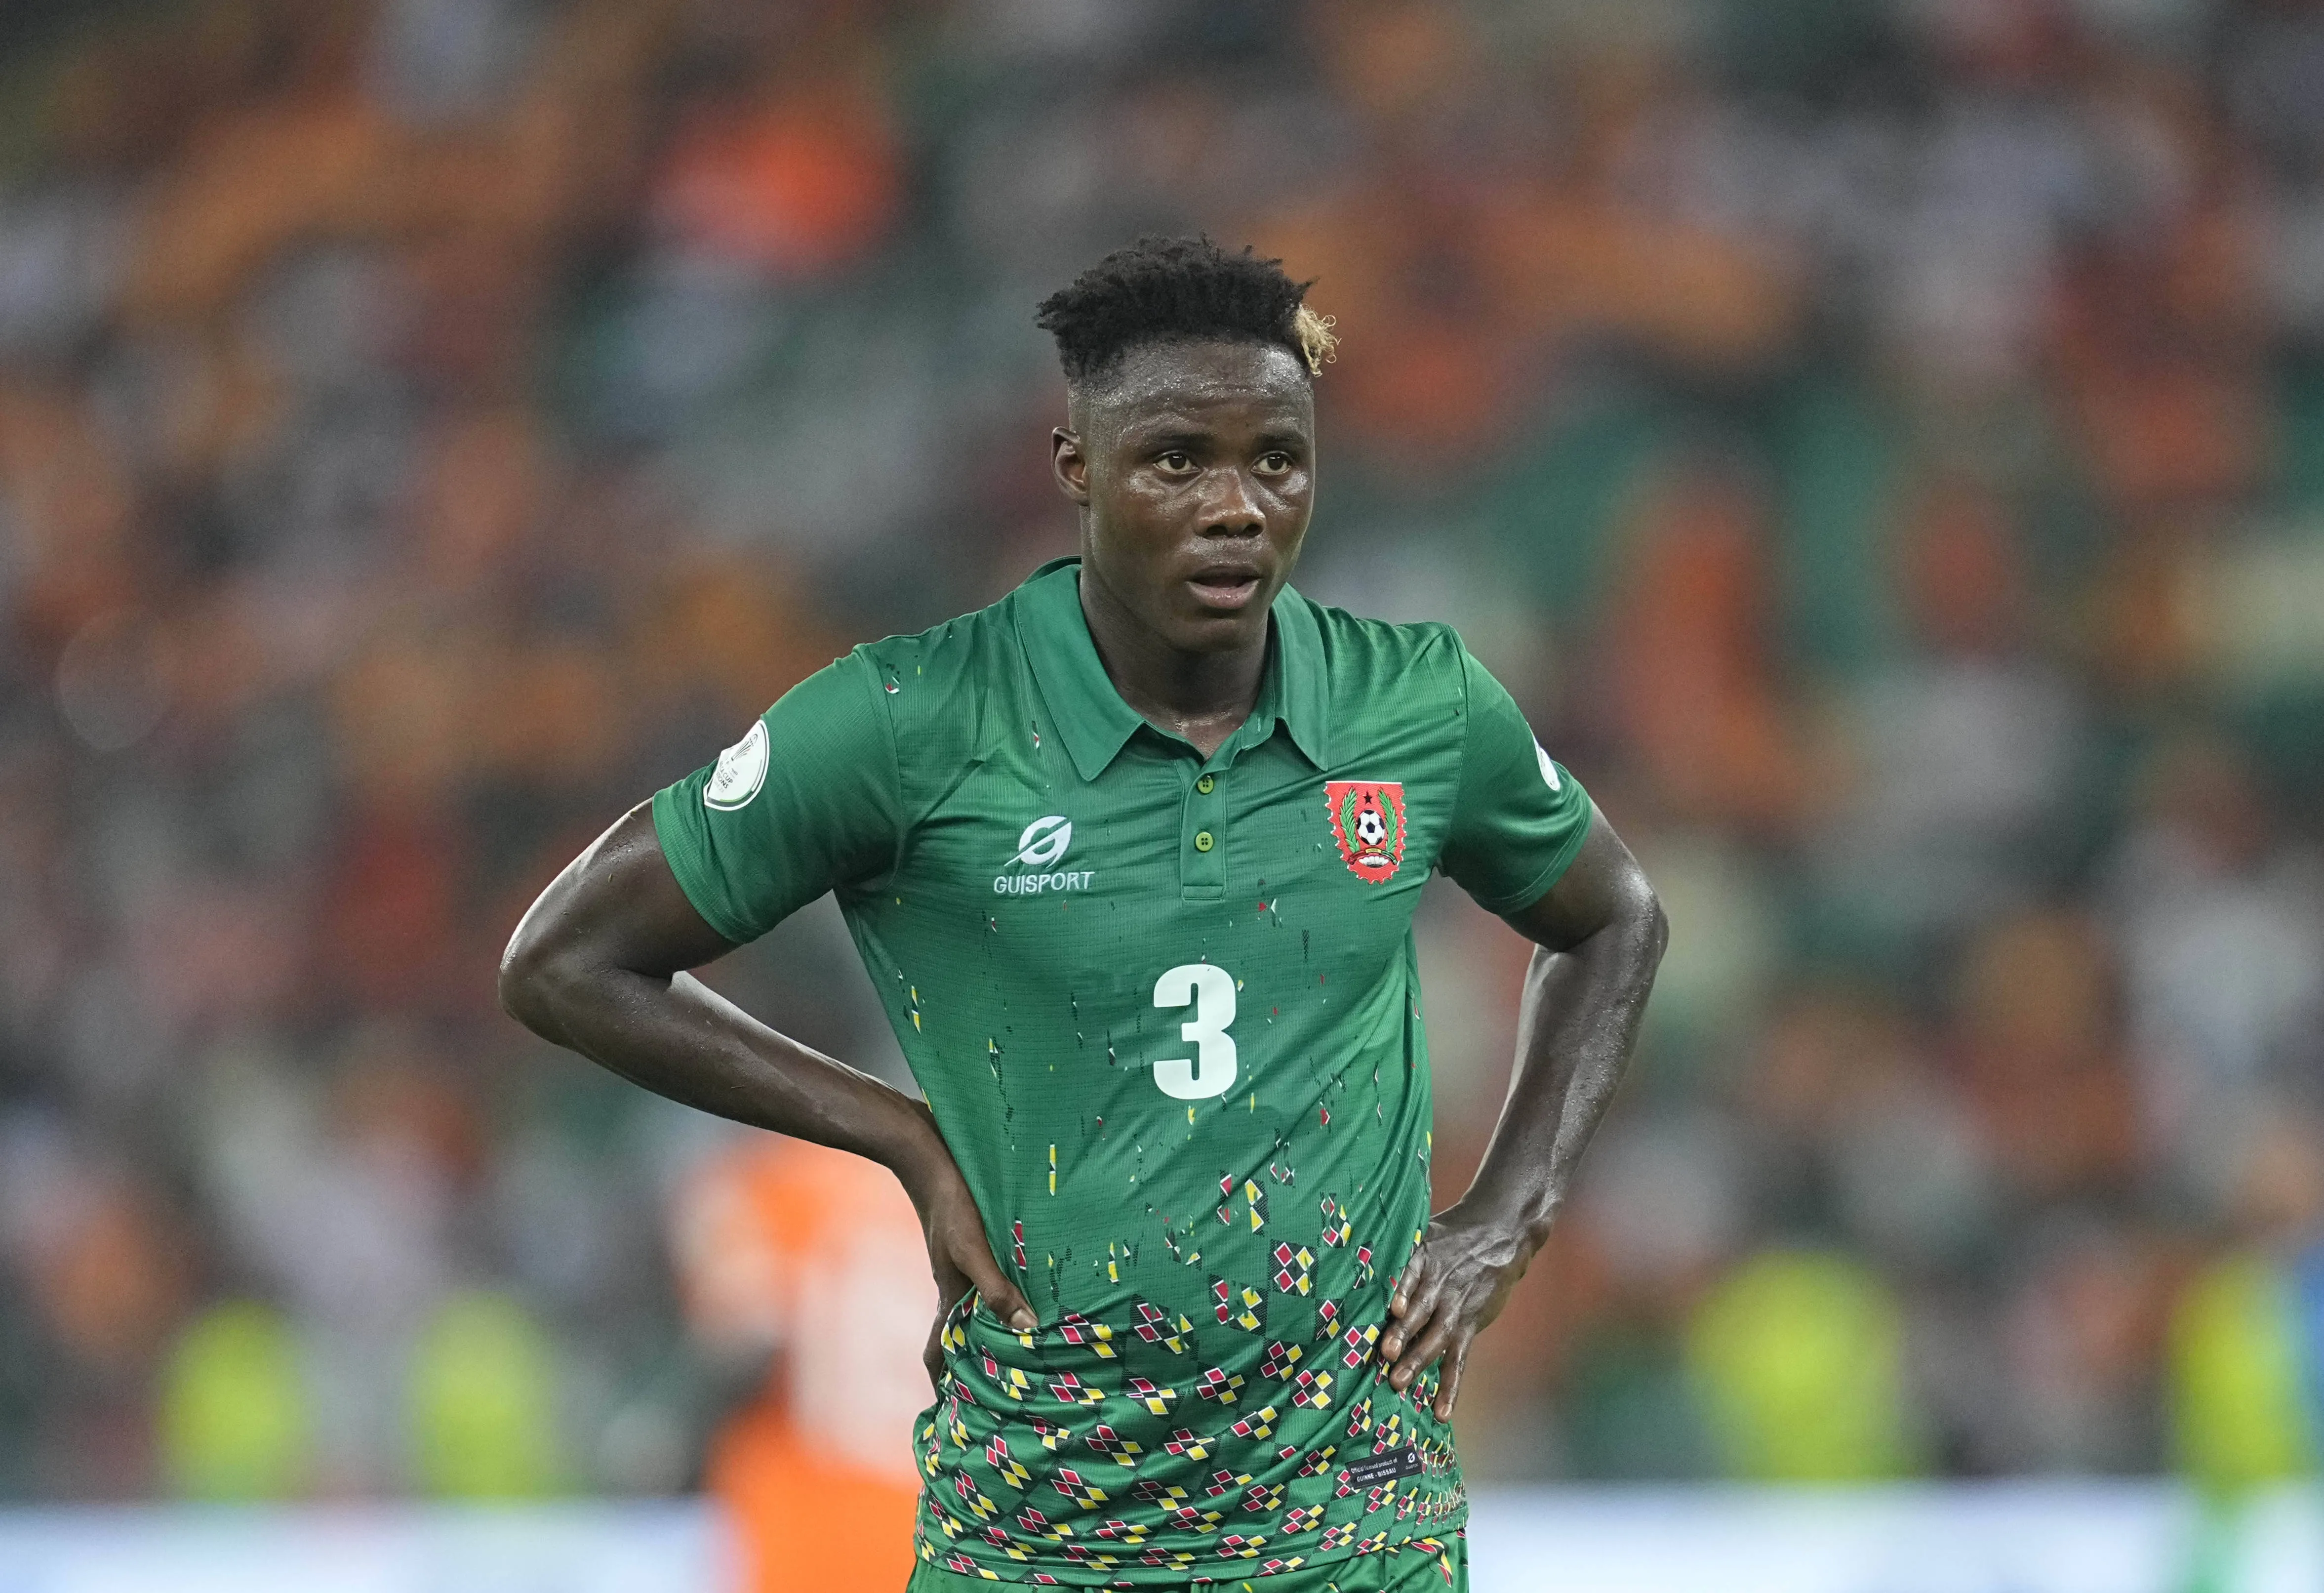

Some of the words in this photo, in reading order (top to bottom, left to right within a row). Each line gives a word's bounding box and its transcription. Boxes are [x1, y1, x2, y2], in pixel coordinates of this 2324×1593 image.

[722, 772, 733, 783] CUP
[994, 871, 1095, 895] GUISPORT
[1153, 964, 1237, 1100] 3
[1357, 1473, 1374, 1482] GUINNE
[1377, 1467, 1397, 1477] BISSAU
